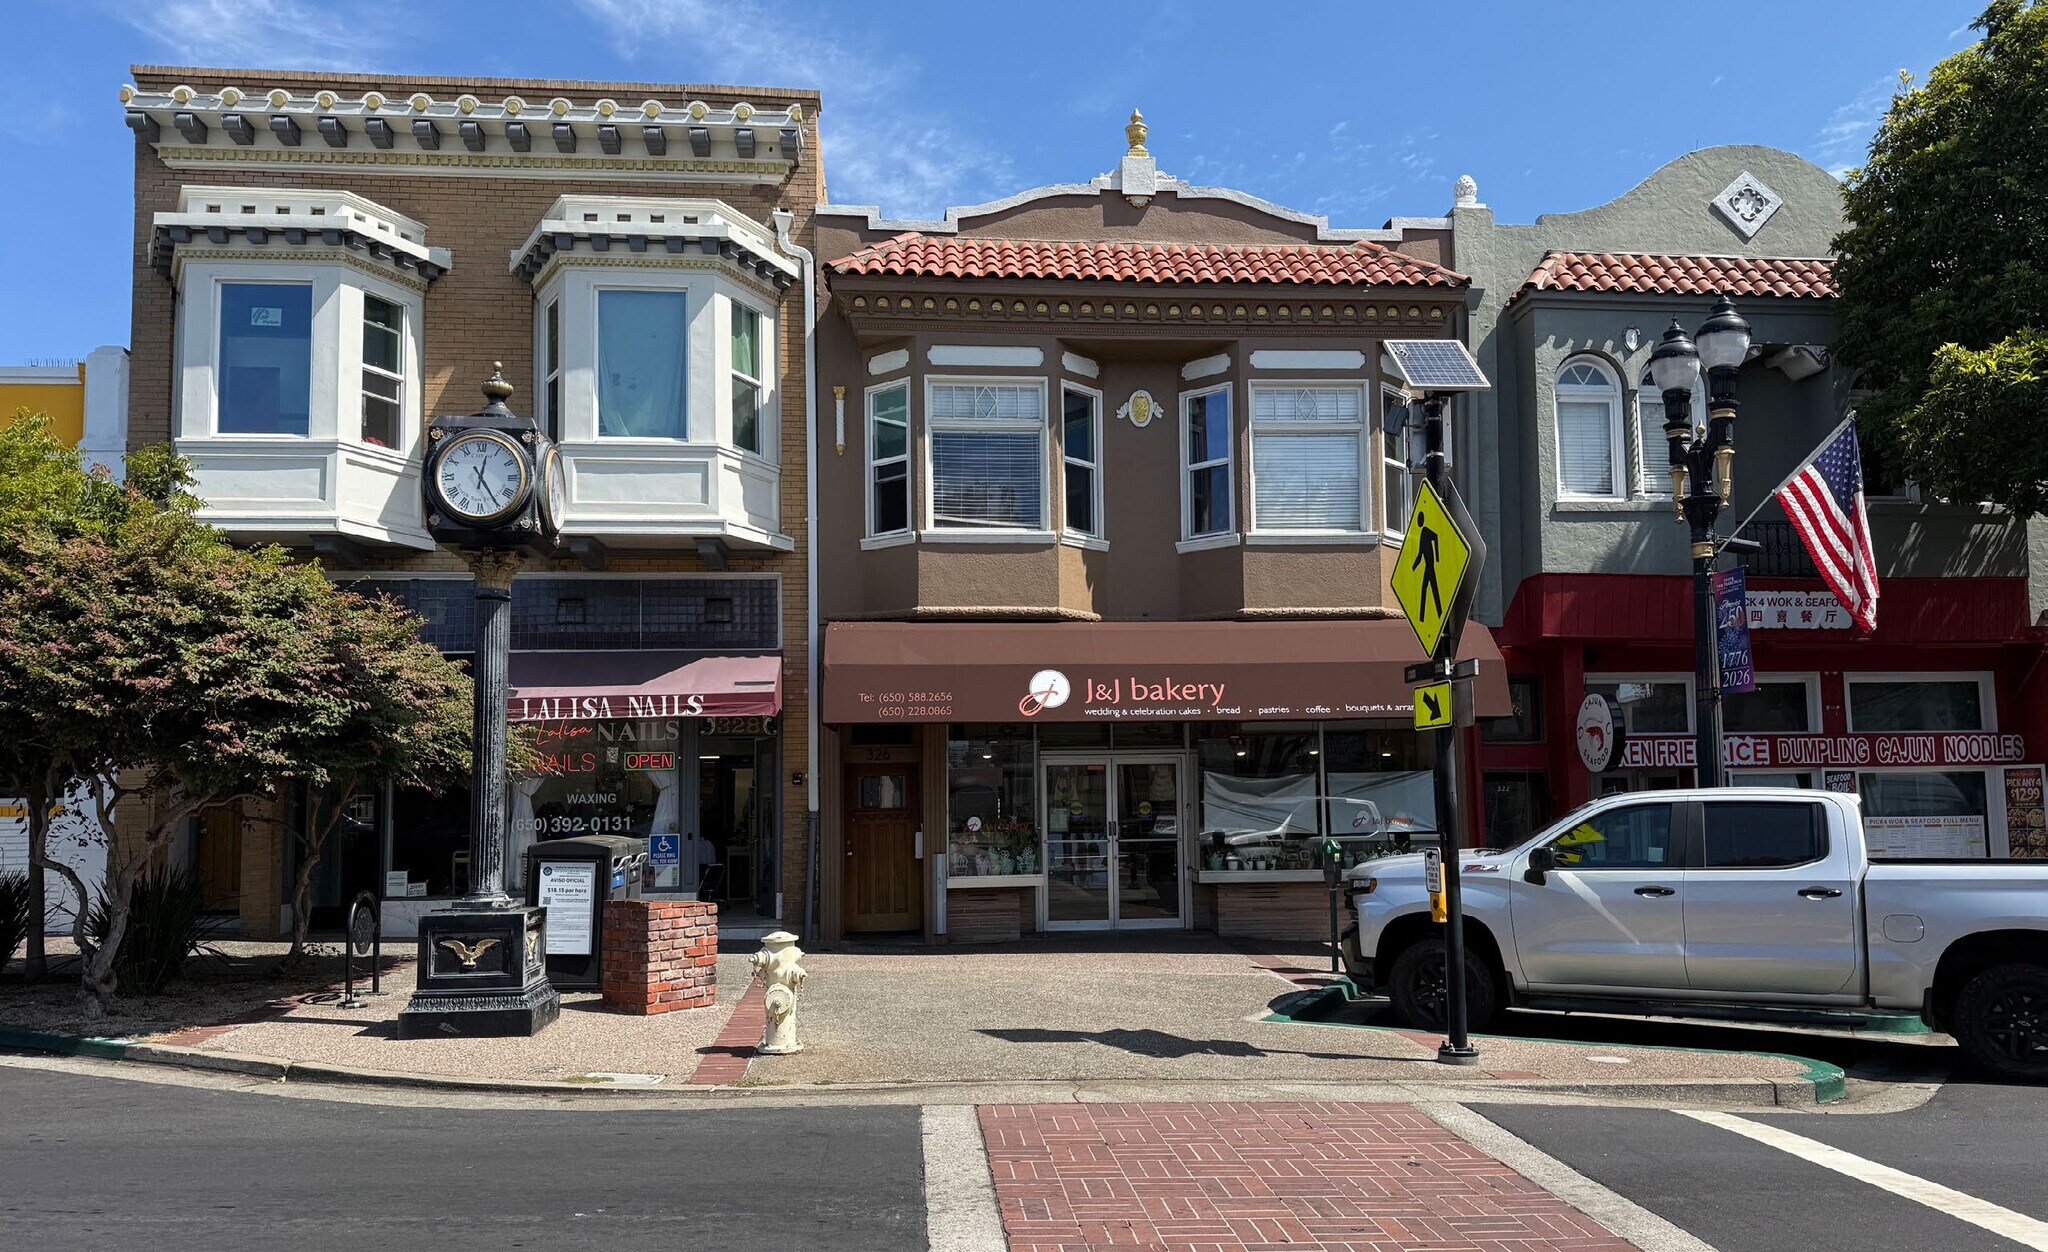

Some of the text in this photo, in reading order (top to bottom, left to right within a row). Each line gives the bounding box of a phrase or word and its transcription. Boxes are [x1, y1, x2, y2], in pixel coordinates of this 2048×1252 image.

[1758, 597, 1765, 607] 4
[1767, 597, 1793, 607] WOK
[1795, 597, 1803, 607] &
[1722, 650, 1749, 669] 1776
[1722, 669, 1751, 688] 2026
[859, 692, 953, 704] Tel: (650) 588.2656
[1084, 677, 1226, 707] J&J bakery
[521, 694, 705, 720] LALISA NAILS
[1084, 707, 1120, 718] wedding
[1122, 708, 1128, 716] &
[1130, 707, 1176, 716] celebration
[1179, 707, 1201, 715] cakes
[1216, 706, 1240, 714] bread
[1258, 706, 1290, 715] pastries
[1305, 705, 1331, 714] coffee
[1345, 704, 1385, 713] bouquets
[1584, 697, 1603, 710] CAJUN
[878, 706, 953, 718] (650) 228.0865
[536, 719, 680, 746] Lalisa NAILS
[718, 717, 760, 733] 328
[1584, 748, 1609, 765] SEAFOOD
[1778, 738, 1869, 763] DUMPLING
[1876, 737, 1935, 762] CAJUN
[1944, 735, 2025, 762] NOODLES
[626, 753, 673, 769] OPEN
[1826, 773, 1851, 784] SEAFOOD
[2006, 777, 2041, 787] PICK ANY 4
[566, 793, 617, 804] WAXING
[511, 816, 632, 833] (650) 392-0131
